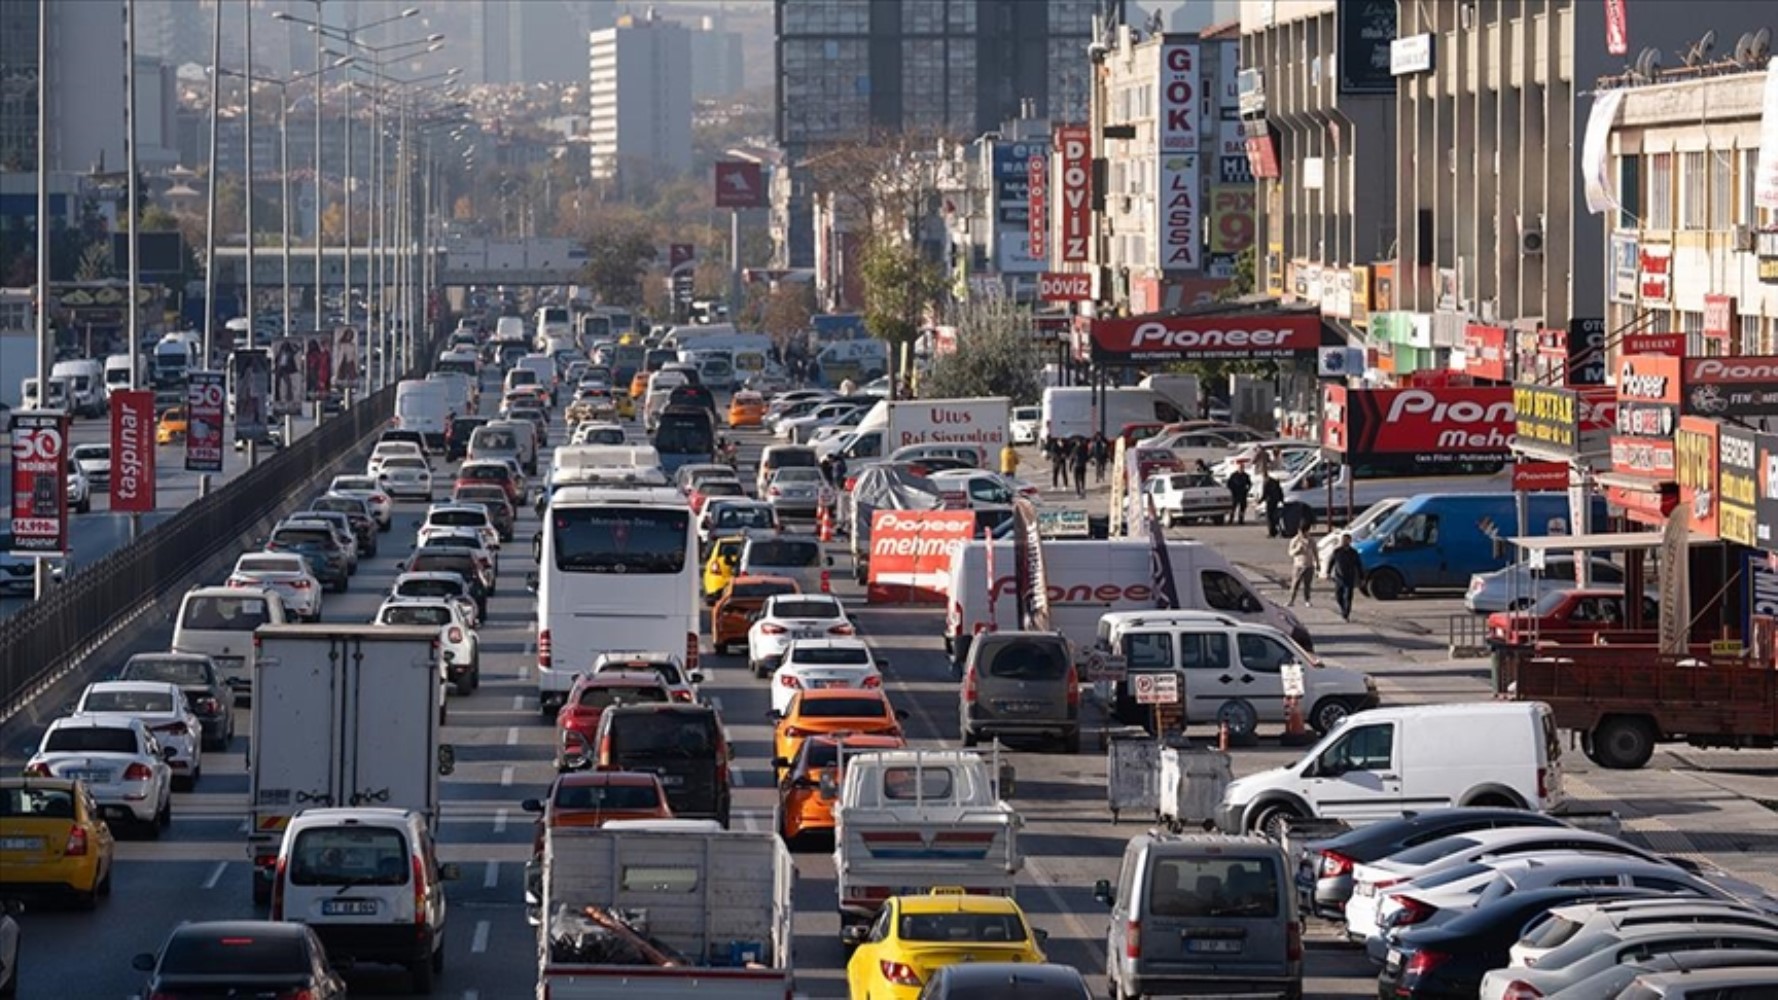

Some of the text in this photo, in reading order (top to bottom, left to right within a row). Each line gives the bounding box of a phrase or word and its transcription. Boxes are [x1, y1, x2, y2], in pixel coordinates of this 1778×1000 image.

[1167, 49, 1191, 131] GÖK
[1032, 160, 1042, 253] OTO TEST
[1065, 141, 1085, 257] DÖVİZ
[1168, 174, 1192, 263] LASSA
[1042, 277, 1089, 296] DÖVİZ
[1131, 322, 1293, 346] Pioneer
[189, 384, 222, 405] 50
[1622, 361, 1666, 397] Pioneer
[11, 429, 62, 459] 50
[875, 515, 971, 531] Pioneer
